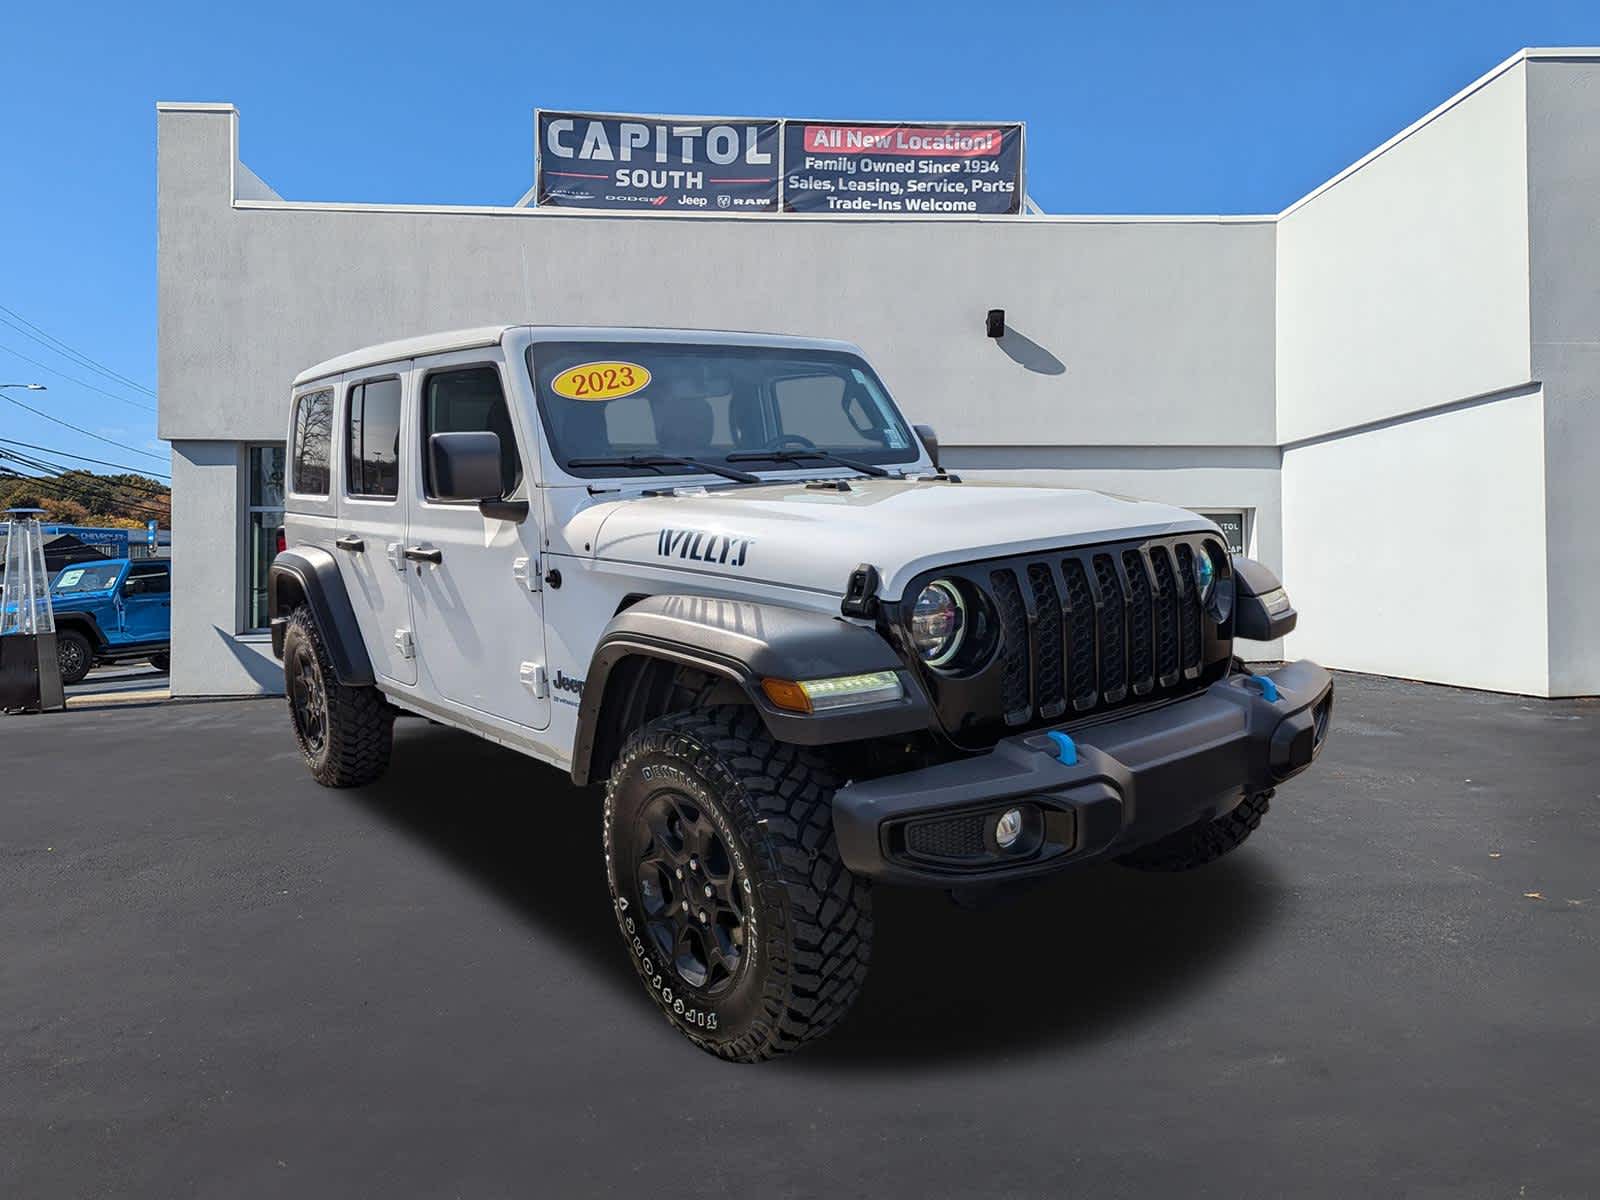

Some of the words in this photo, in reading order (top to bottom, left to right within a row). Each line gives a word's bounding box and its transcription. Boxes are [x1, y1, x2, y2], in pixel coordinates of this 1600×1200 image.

[547, 119, 772, 165] CAPITOL
[813, 129, 841, 148] All
[847, 130, 892, 149] New
[896, 132, 993, 151] Location!
[805, 157, 857, 174] Family
[860, 158, 914, 173] Owned
[918, 159, 960, 173] Since
[963, 160, 1000, 174] 1934
[615, 168, 703, 190] SOUTH
[788, 176, 835, 191] Sales,
[838, 177, 904, 195] Leasing,
[906, 179, 968, 194] Service,
[972, 179, 1015, 193] Parts
[678, 194, 708, 207] Jeep
[827, 196, 901, 211] Trade-Ins
[905, 198, 977, 212] Welcome
[572, 367, 636, 396] 2023
[658, 528, 756, 566] WILLYS
